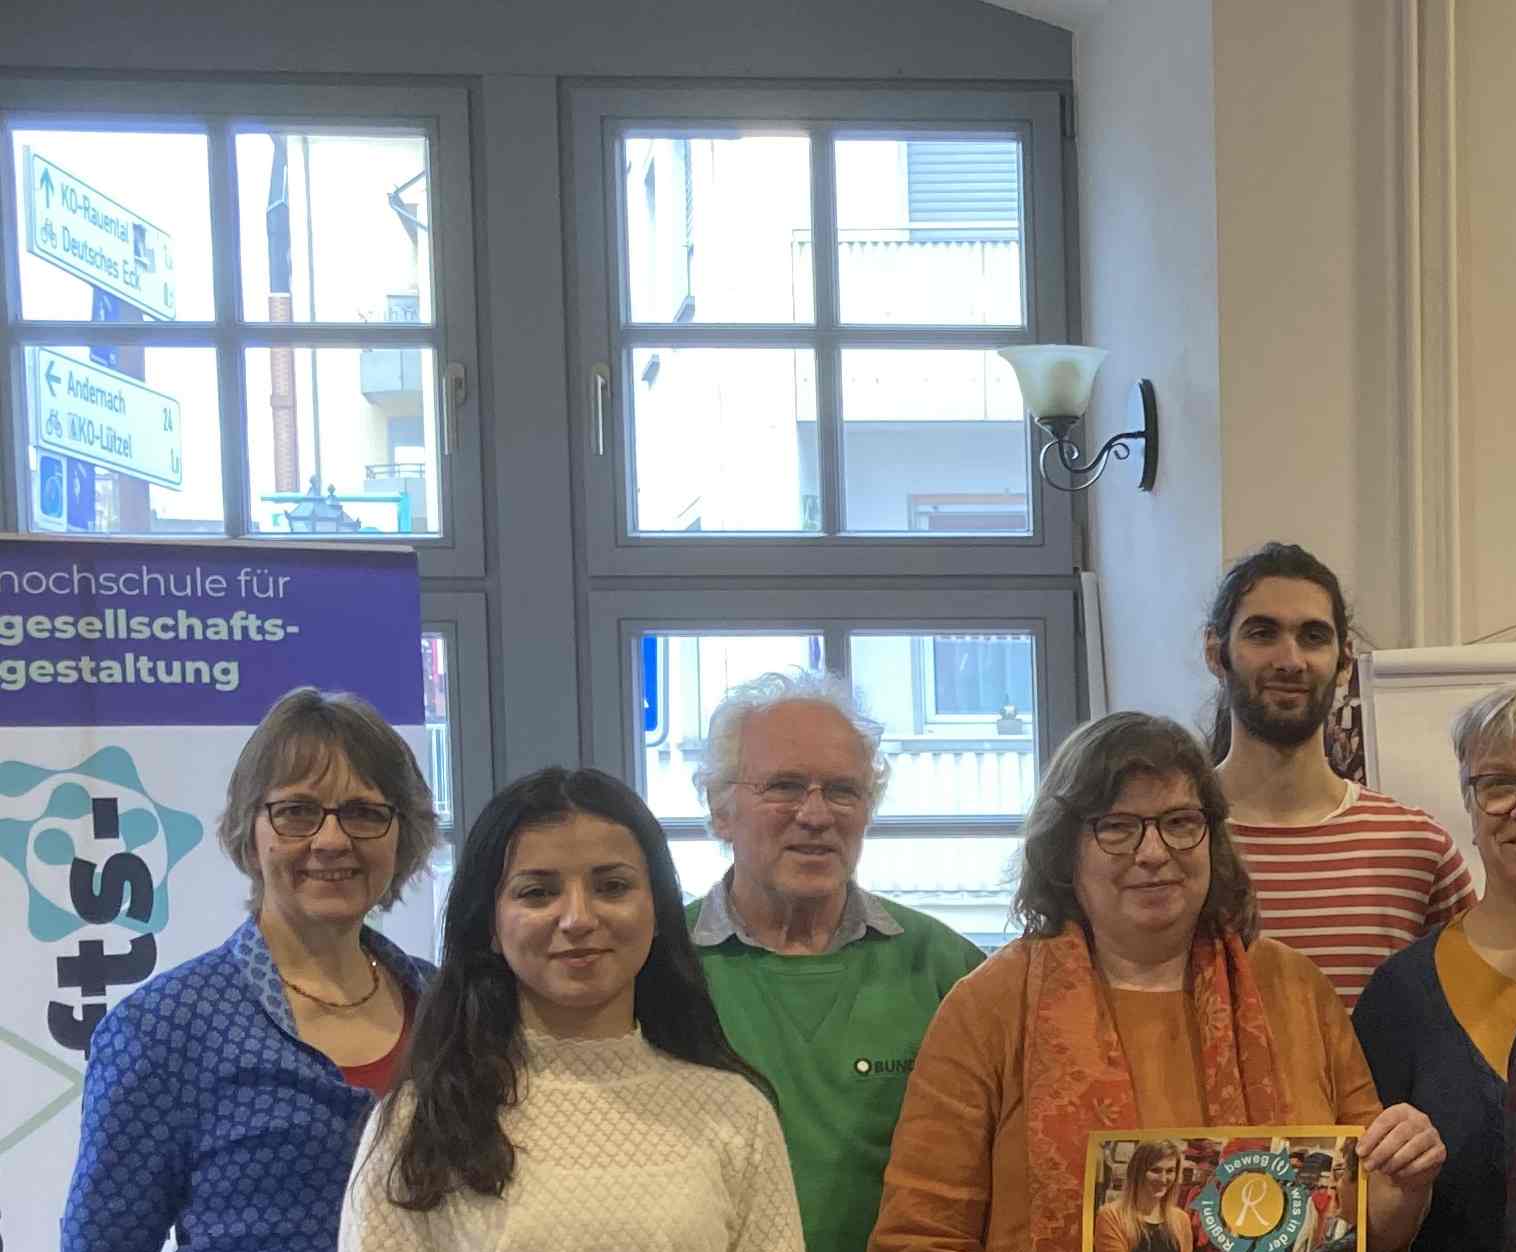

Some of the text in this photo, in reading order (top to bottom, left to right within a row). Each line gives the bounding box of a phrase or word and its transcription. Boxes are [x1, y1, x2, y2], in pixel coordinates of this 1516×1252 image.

[60, 182, 129, 244] KO-Rauental
[61, 225, 119, 279] Deutsches
[66, 371, 174, 432] Andernach 24
[236, 567, 291, 598] für
[0, 608, 300, 646] gesellschafts-
[0, 652, 240, 692] gestaltung
[1268, 1233, 1289, 1252] der
